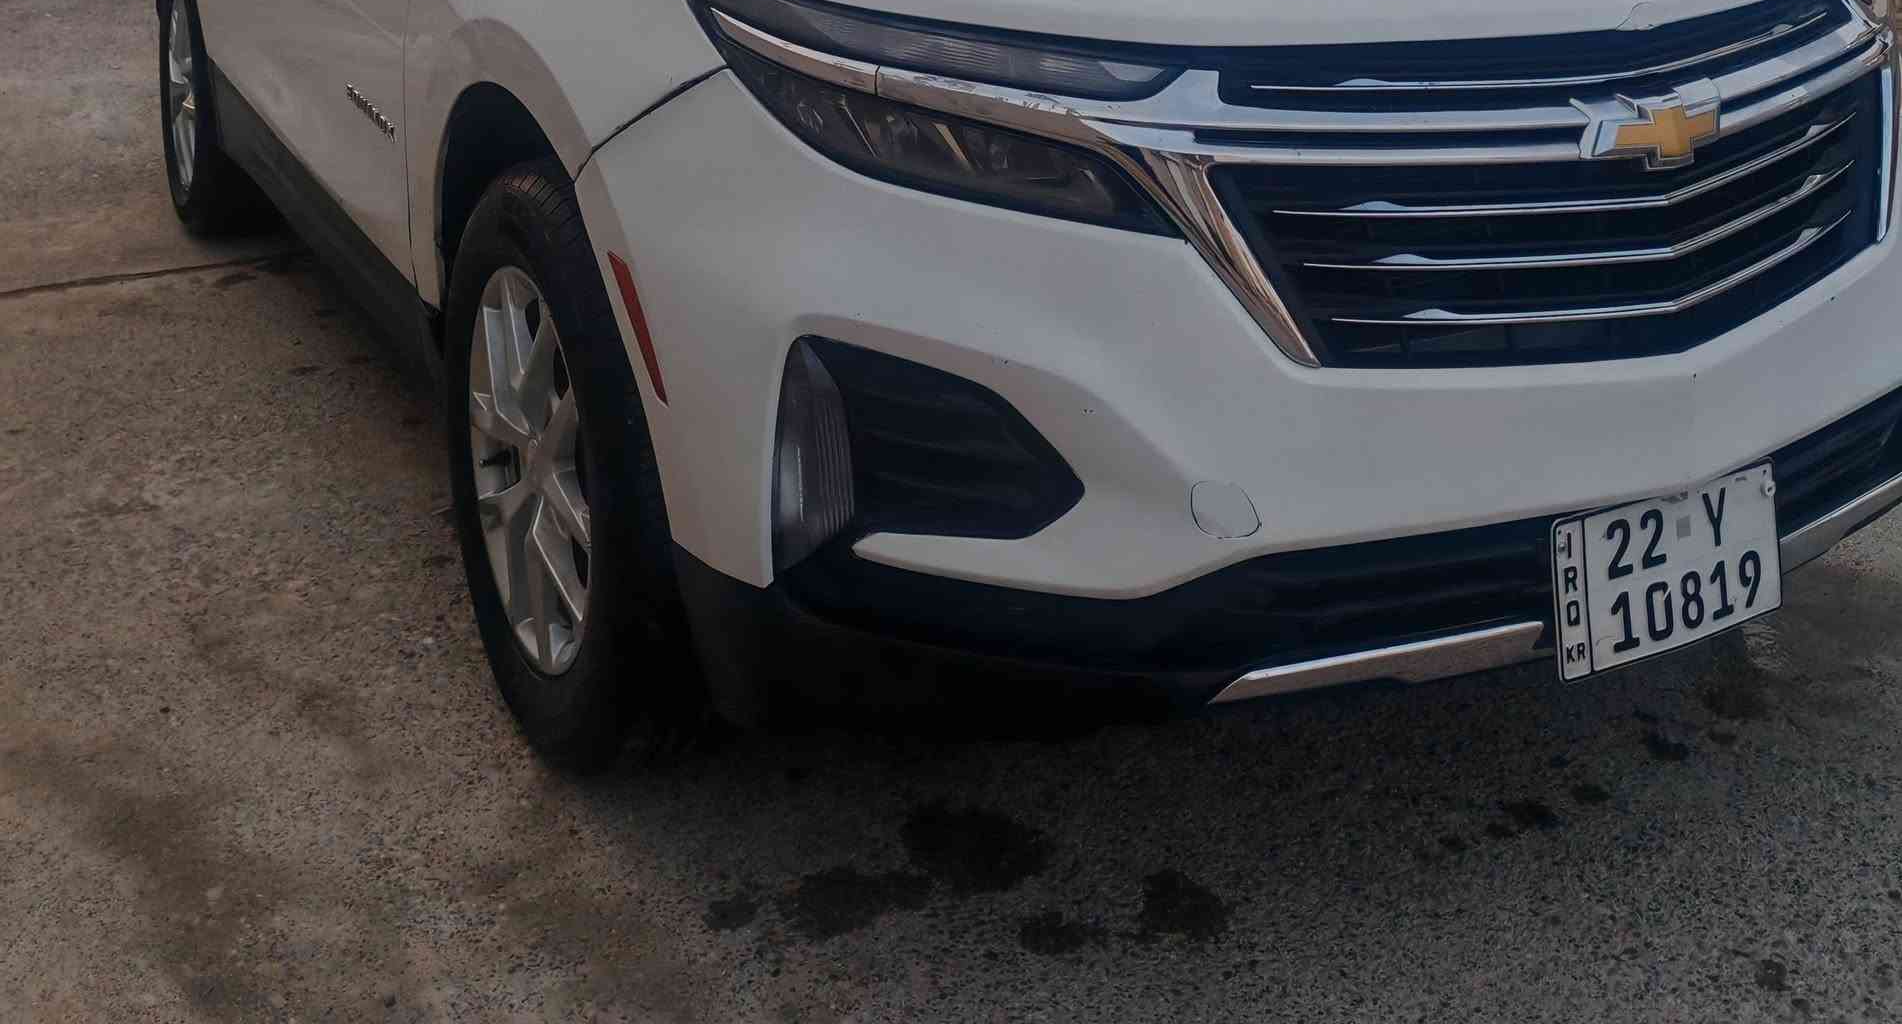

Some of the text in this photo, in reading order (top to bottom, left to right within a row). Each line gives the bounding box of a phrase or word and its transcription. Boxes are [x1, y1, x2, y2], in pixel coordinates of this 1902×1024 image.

[1606, 487, 1726, 580] 22 Y
[1610, 550, 1761, 653] 10819
[1566, 642, 1586, 664] KR
